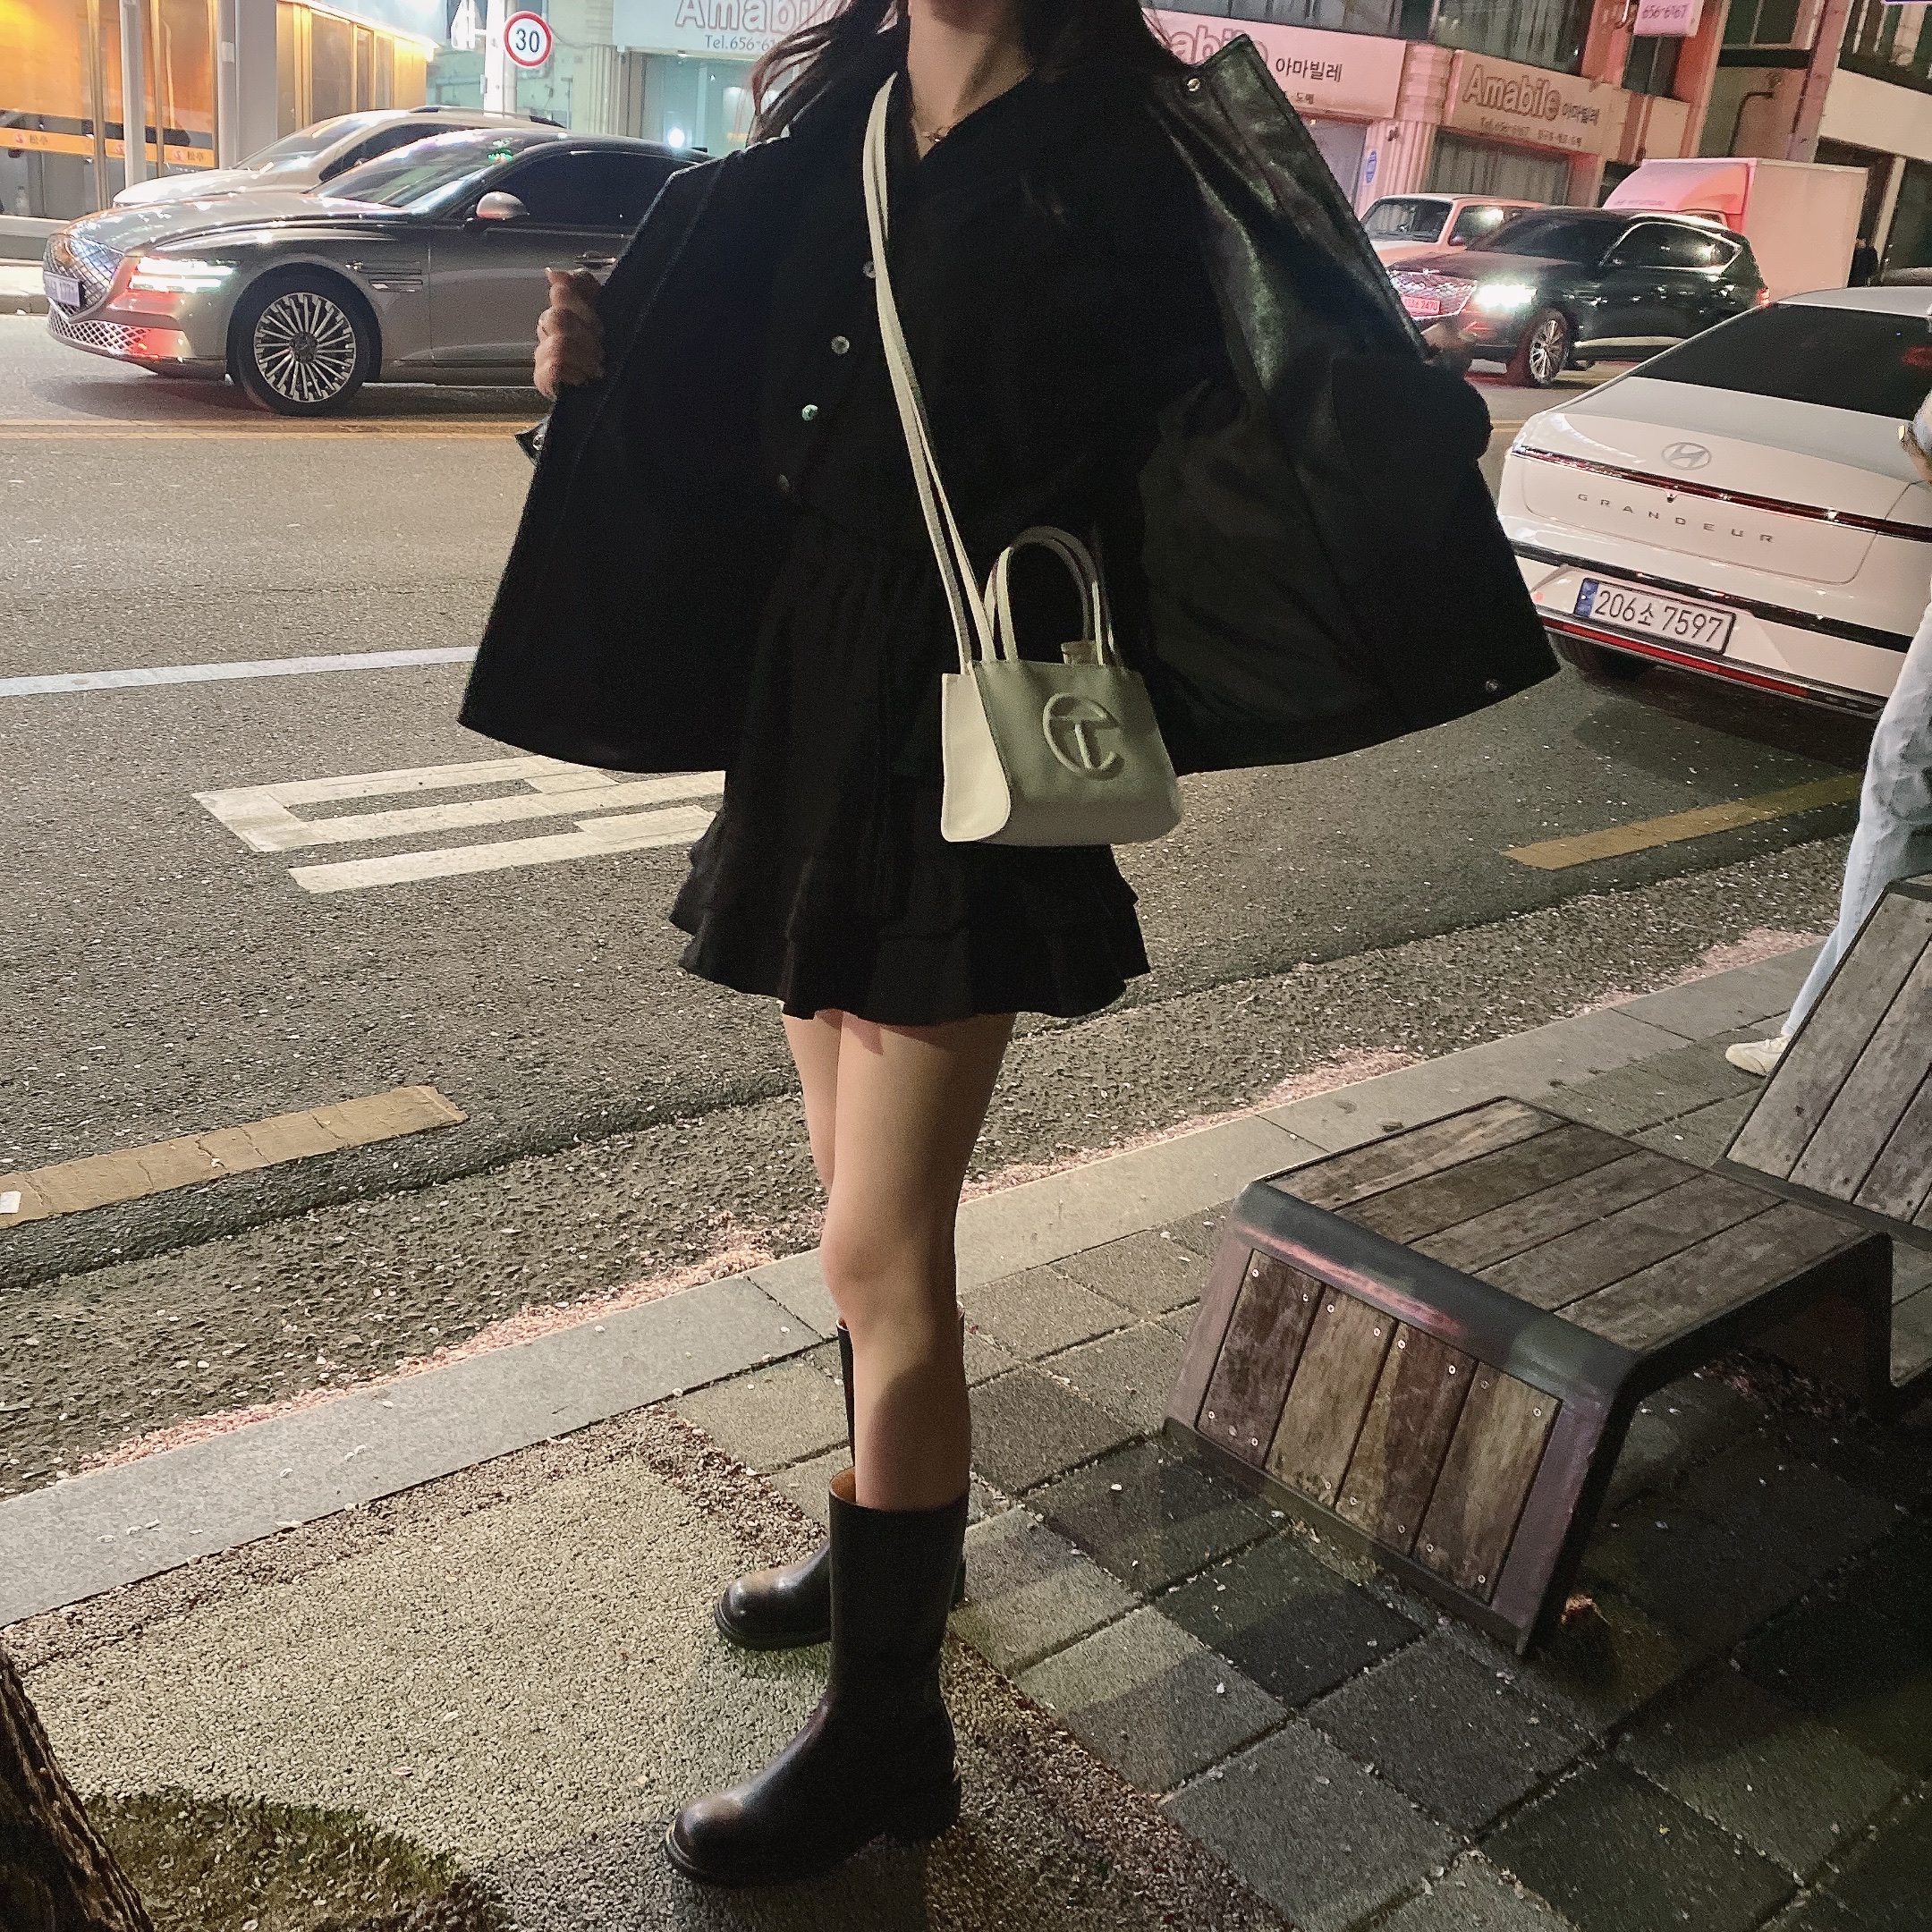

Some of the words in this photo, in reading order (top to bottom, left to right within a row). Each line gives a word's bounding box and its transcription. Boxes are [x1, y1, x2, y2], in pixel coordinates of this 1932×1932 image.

[515, 28, 540, 53] 30
[1275, 57, 1343, 82] 아마빌레
[1462, 64, 1561, 121] Amabile
[1578, 493, 1774, 543] GRANDEUR
[1595, 589, 1656, 627] 206소
[1662, 605, 1724, 643] 7597
